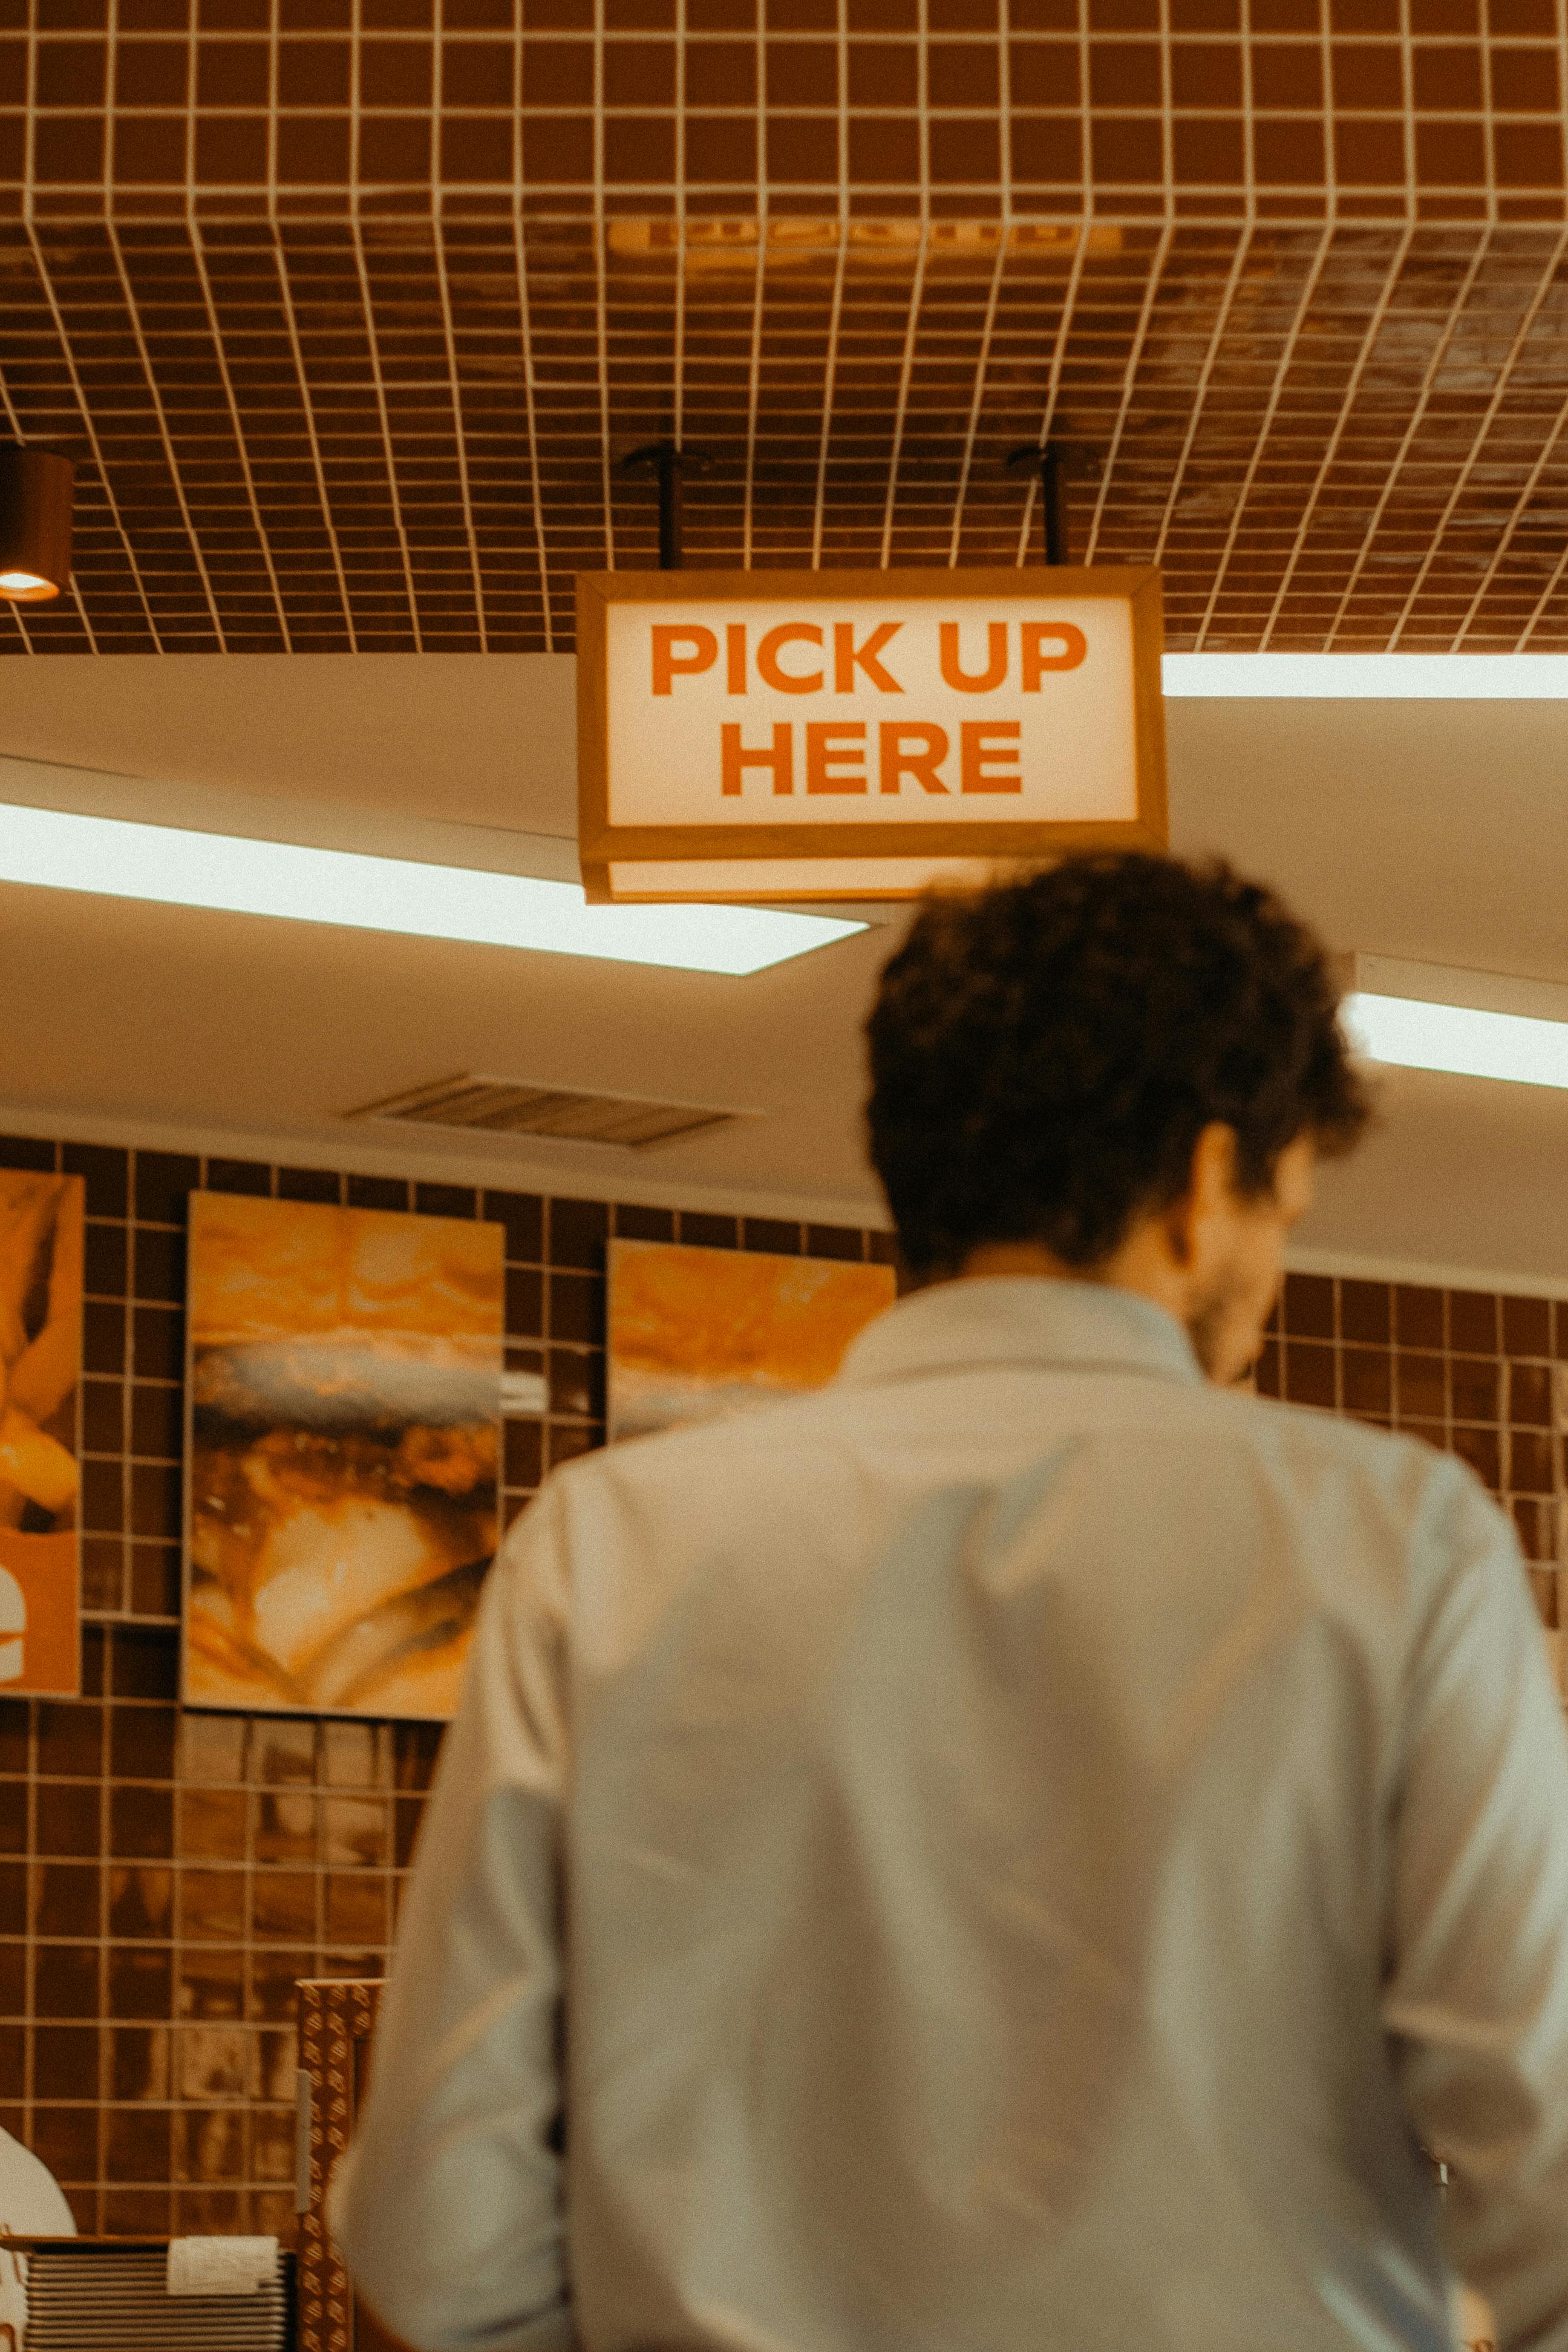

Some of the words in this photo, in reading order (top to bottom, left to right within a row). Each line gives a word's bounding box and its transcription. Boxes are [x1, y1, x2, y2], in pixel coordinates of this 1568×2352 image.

[651, 622, 904, 696] PICK
[938, 622, 1088, 693] UP
[720, 721, 1022, 795] HERE
